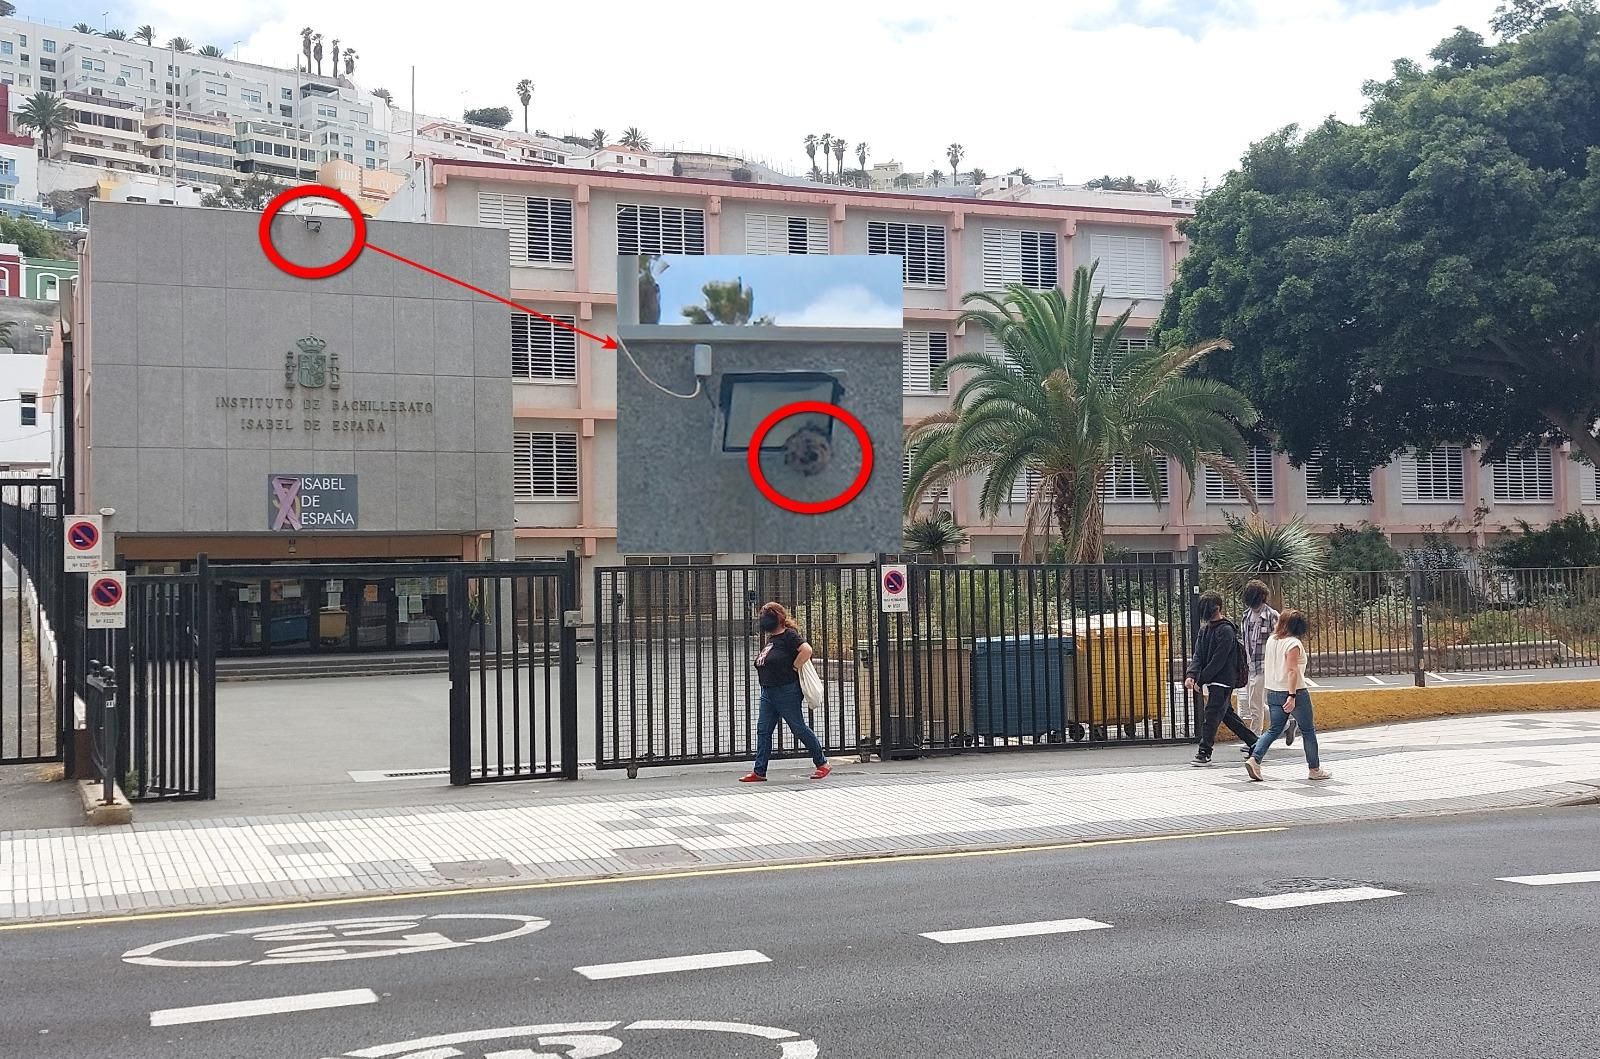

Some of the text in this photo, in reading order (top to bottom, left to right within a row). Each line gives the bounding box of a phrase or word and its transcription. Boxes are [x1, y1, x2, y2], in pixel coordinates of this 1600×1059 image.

[215, 396, 433, 414] INSTITUTO DE BACHILLERATO
[240, 418, 386, 433] ISABEL DE ESPAÑA
[301, 477, 346, 490] ISABEL
[301, 495, 320, 508] DE
[301, 509, 355, 525] ESPAÑA
